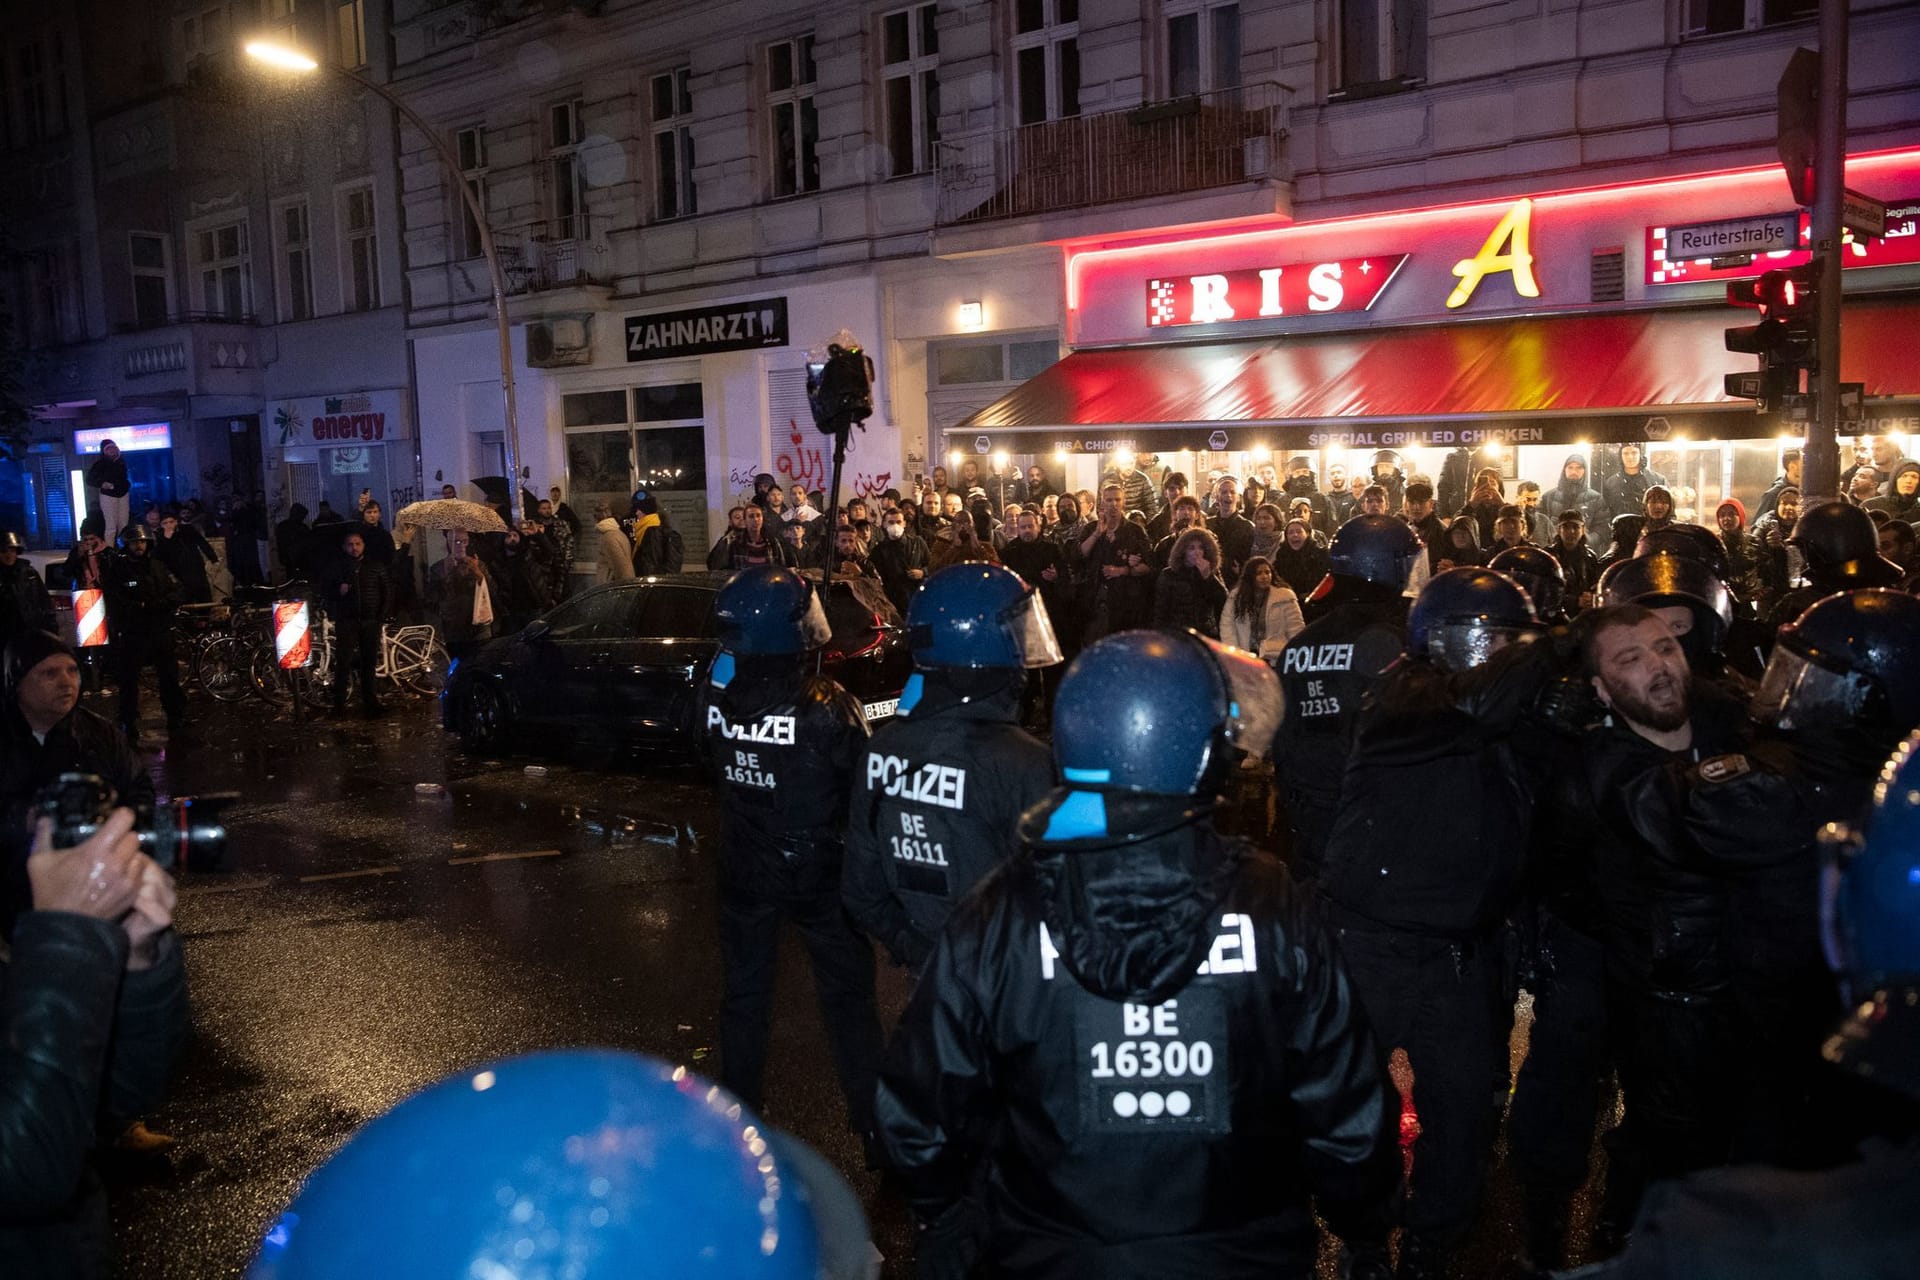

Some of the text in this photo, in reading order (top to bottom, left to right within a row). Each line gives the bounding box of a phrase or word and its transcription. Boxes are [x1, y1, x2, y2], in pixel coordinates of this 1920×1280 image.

[1681, 222, 1785, 249] Reuterstraße
[1446, 198, 1540, 309] A
[1190, 262, 1345, 322] RIS
[628, 311, 757, 351] ZAHNARZT
[312, 412, 385, 441] energy
[1307, 428, 1543, 446] SPECIAL GRILLED CHICKEN
[1085, 439, 1137, 450] CHICKEN
[1283, 644, 1354, 674] POLIZEI
[1307, 680, 1325, 697] BE
[1300, 697, 1340, 717] 22313
[735, 750, 760, 769] BE
[724, 765, 777, 789] 16114
[866, 752, 966, 810] POLIZEI
[900, 811, 928, 838] BE
[891, 835, 949, 866] 16111
[1123, 999, 1179, 1036] BE
[1091, 1040, 1214, 1078] 16300
